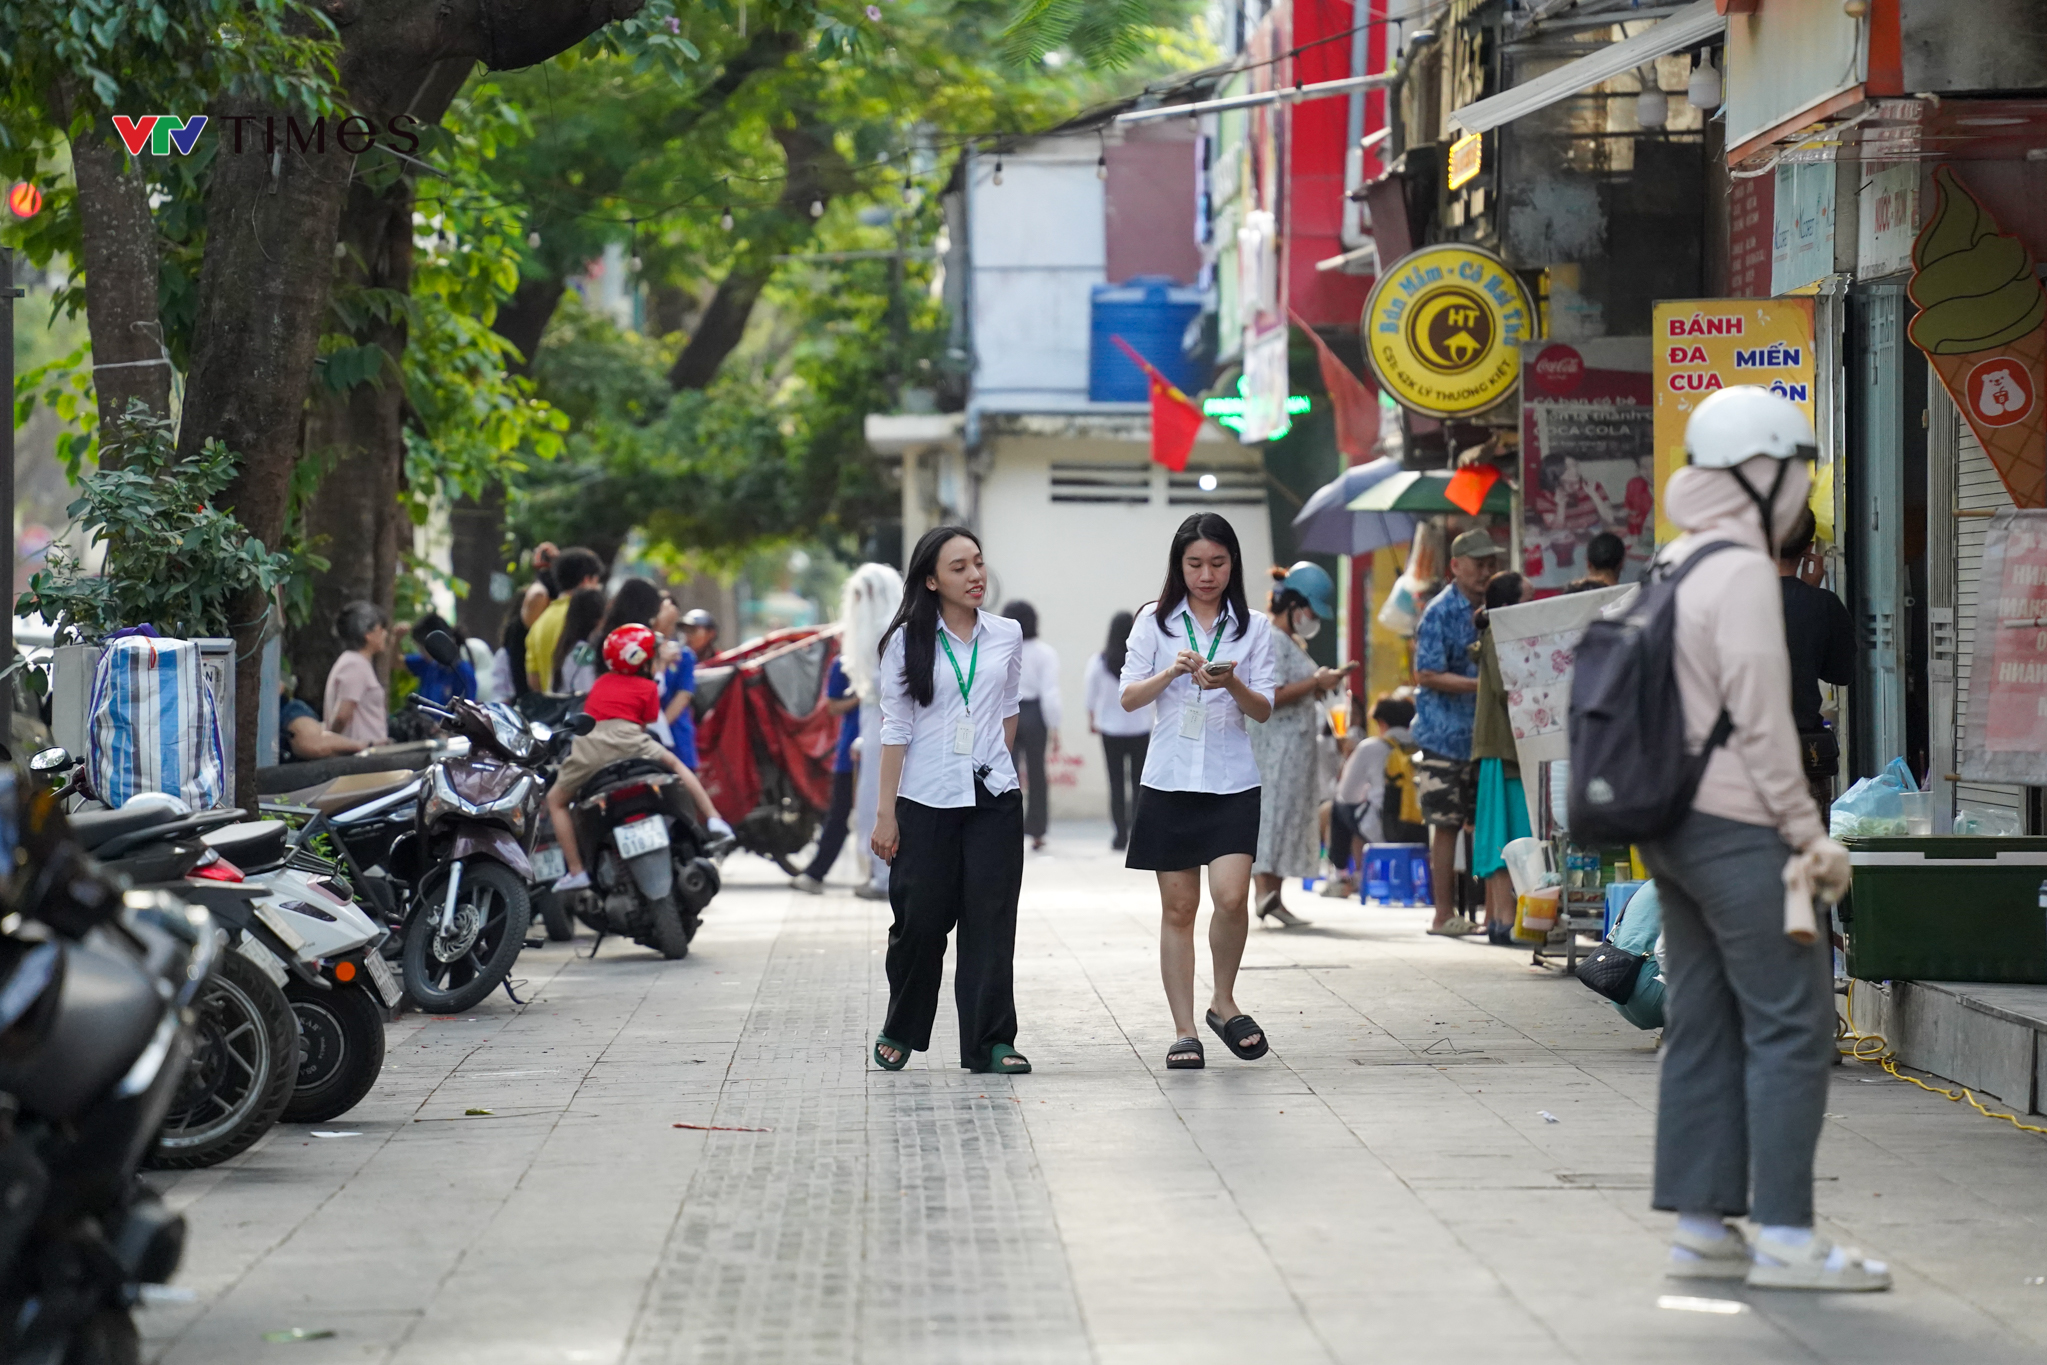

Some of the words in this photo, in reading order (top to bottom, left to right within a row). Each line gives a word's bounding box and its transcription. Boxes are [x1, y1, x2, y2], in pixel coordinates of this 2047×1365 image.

[1447, 308, 1480, 328] HT
[1668, 313, 1743, 337] BÁNH
[1668, 346, 1708, 364] ĐA
[1736, 342, 1800, 368] MIẾN
[1668, 372, 1724, 392] CUA
